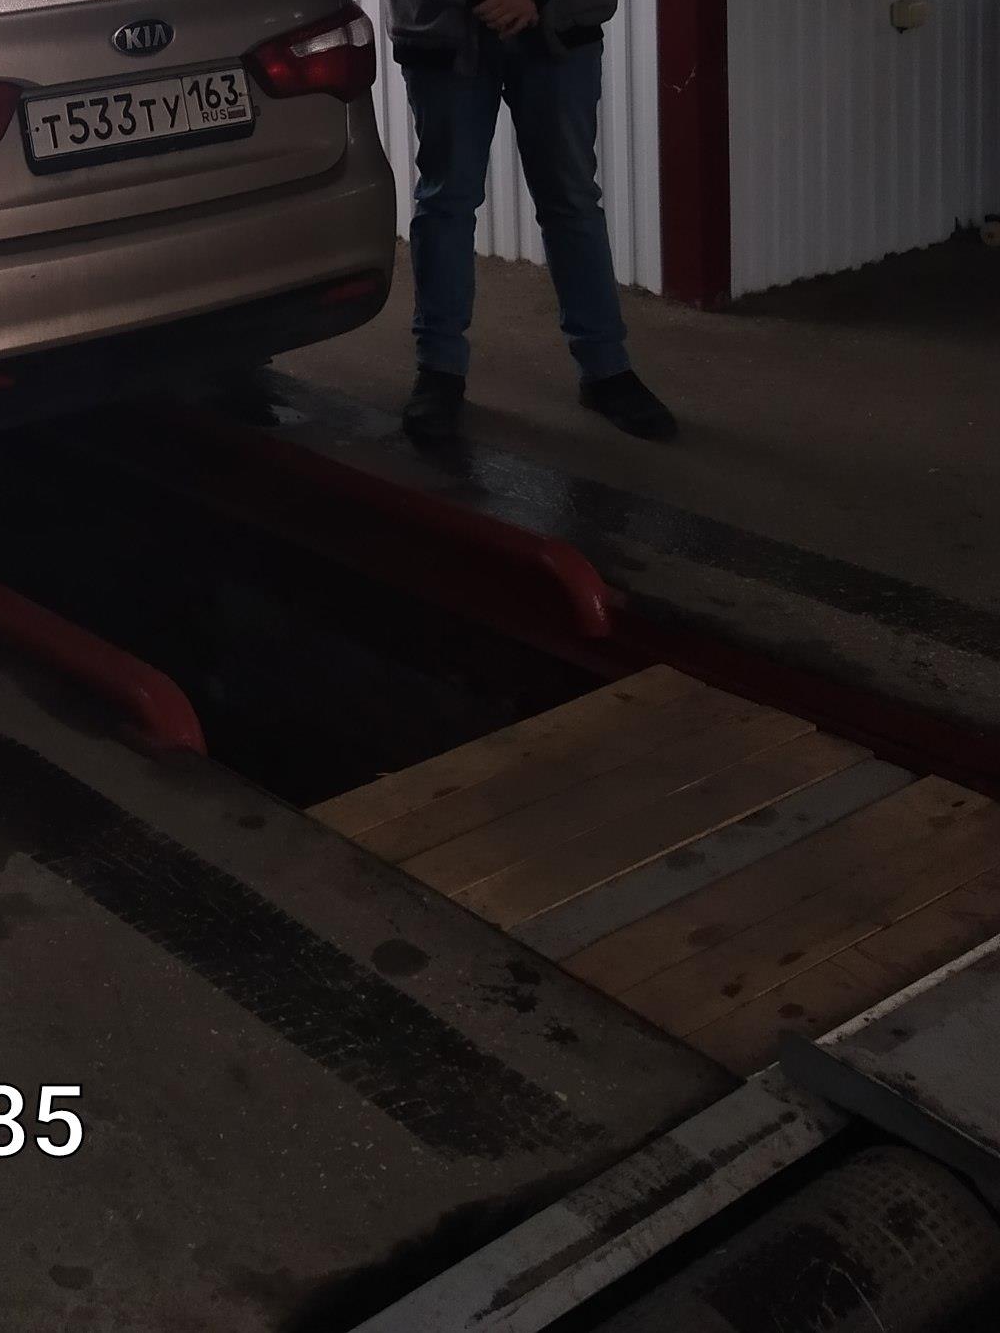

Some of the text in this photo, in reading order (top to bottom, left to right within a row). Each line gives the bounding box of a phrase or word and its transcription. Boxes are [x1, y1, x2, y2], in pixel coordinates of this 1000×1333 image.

[124, 26, 168, 50] KIA
[42, 74, 239, 149] Т533ТУ 163
[202, 109, 227, 123] RUS
